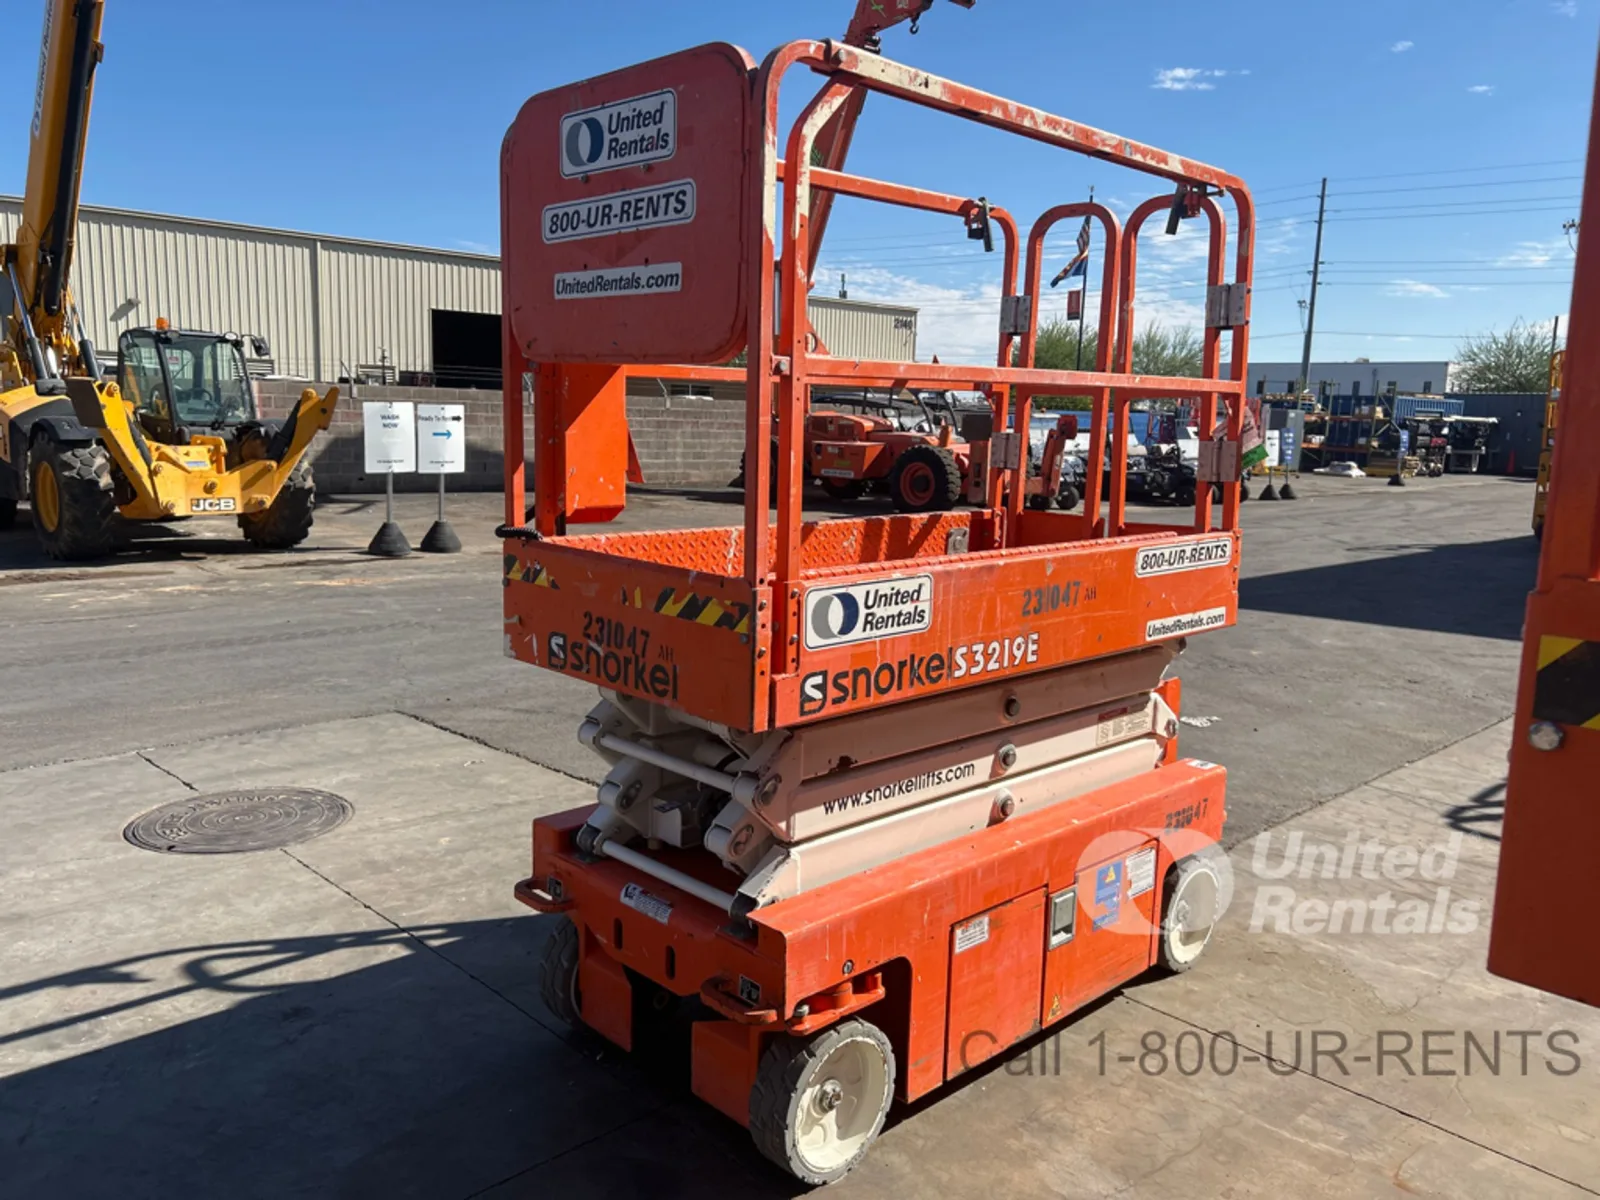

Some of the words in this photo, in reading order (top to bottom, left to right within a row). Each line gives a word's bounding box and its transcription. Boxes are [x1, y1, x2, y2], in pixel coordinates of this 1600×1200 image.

[607, 101, 665, 135] United
[607, 128, 670, 160] Rentals
[549, 189, 688, 234] 800-UR-RENTS
[556, 270, 680, 296] UnitedRentals.com
[192, 498, 236, 511] JCB
[1141, 543, 1228, 570] 800-UR-RENTS
[864, 583, 923, 610] United
[1021, 581, 1081, 616] 231047
[582, 611, 650, 658] 231047
[862, 605, 926, 632] Rentals
[1147, 613, 1225, 638] UnitedRentals.com
[569, 641, 678, 700] snorkel
[831, 646, 952, 706] snorkel
[953, 632, 1039, 678] S3219E
[823, 763, 975, 815] www.snorkellifts.com
